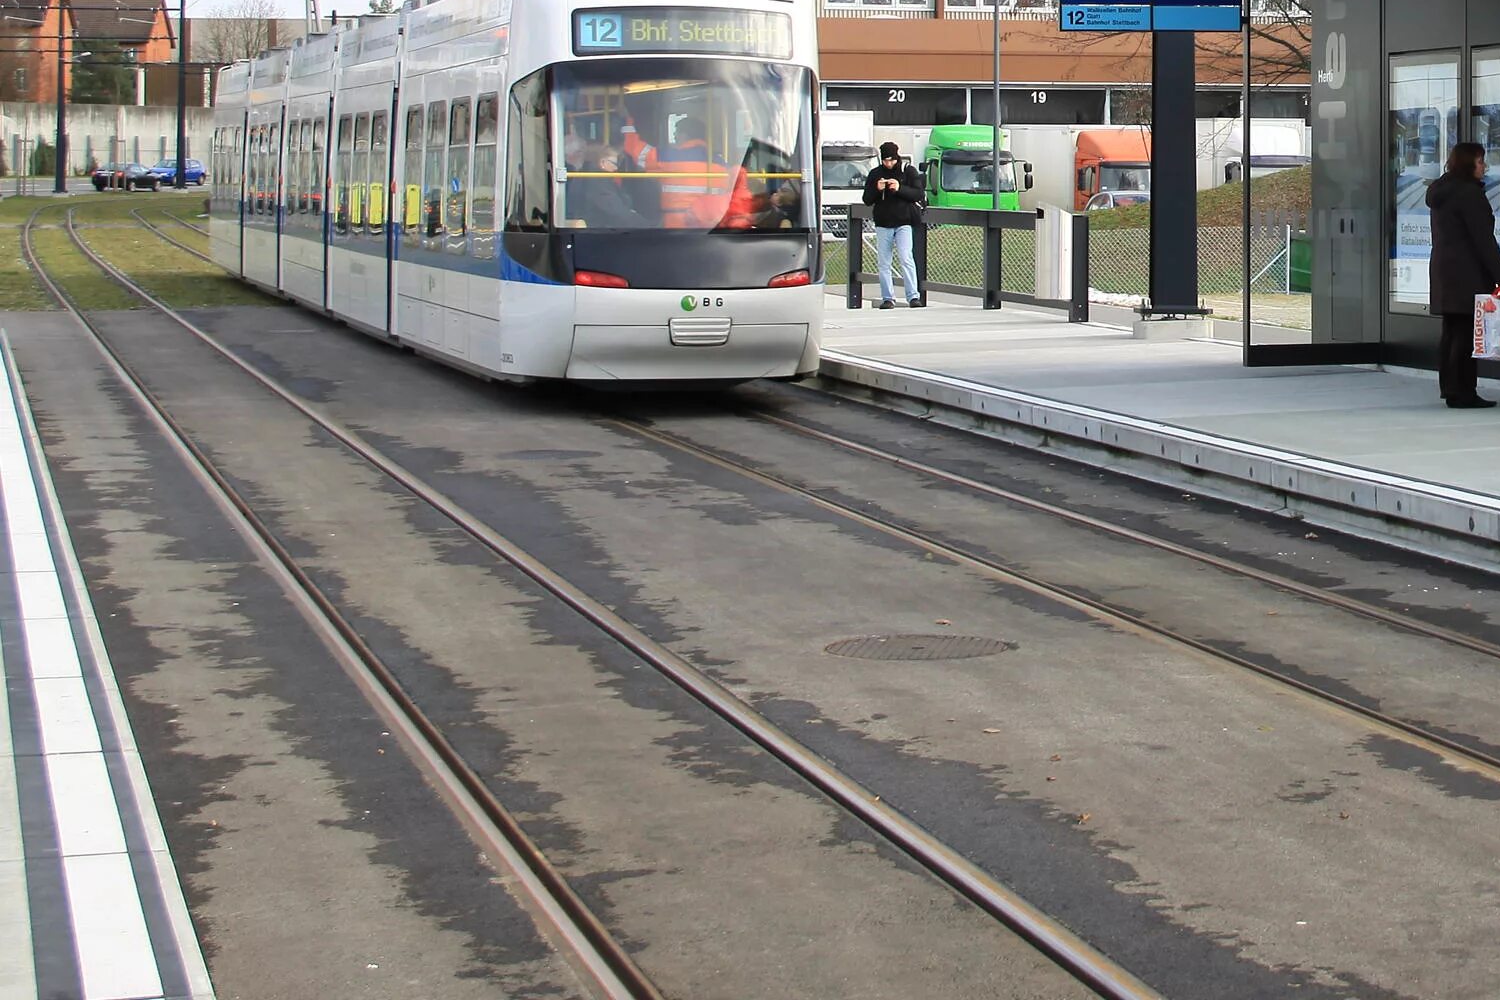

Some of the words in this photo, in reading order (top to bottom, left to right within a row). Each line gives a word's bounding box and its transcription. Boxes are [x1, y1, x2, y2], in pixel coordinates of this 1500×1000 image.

[1067, 10, 1084, 25] 12
[585, 19, 617, 42] 12
[631, 19, 673, 41] Bhf.
[888, 89, 906, 103] 20
[1030, 91, 1047, 104] 19
[1474, 301, 1485, 354] MIGROS
